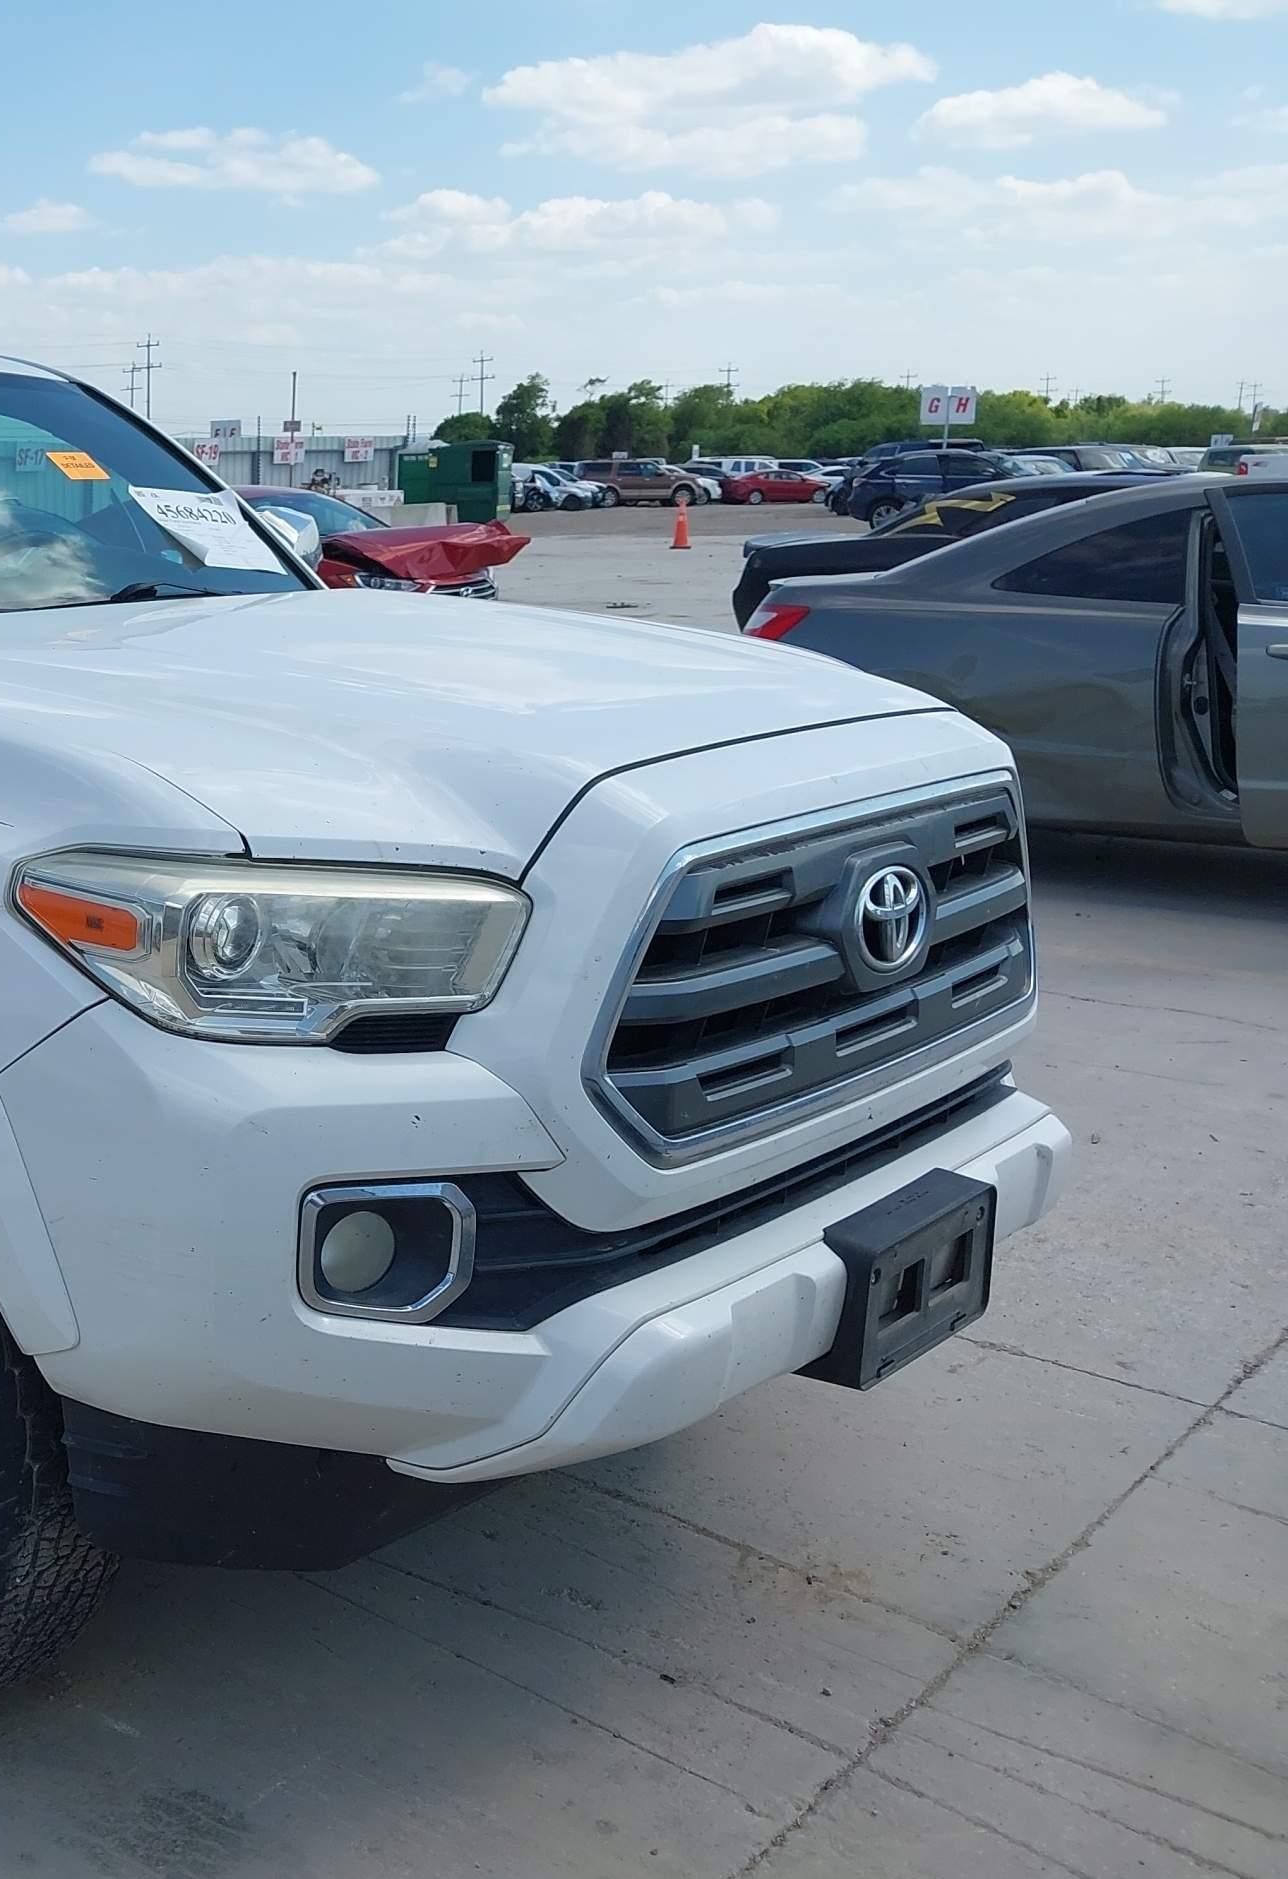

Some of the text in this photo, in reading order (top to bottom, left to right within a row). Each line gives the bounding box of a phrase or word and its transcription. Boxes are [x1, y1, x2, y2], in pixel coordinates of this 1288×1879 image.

[927, 396, 971, 415] G H
[18, 447, 46, 467] SF-17
[195, 444, 219, 461] SF-19
[155, 503, 238, 526] 45684220
